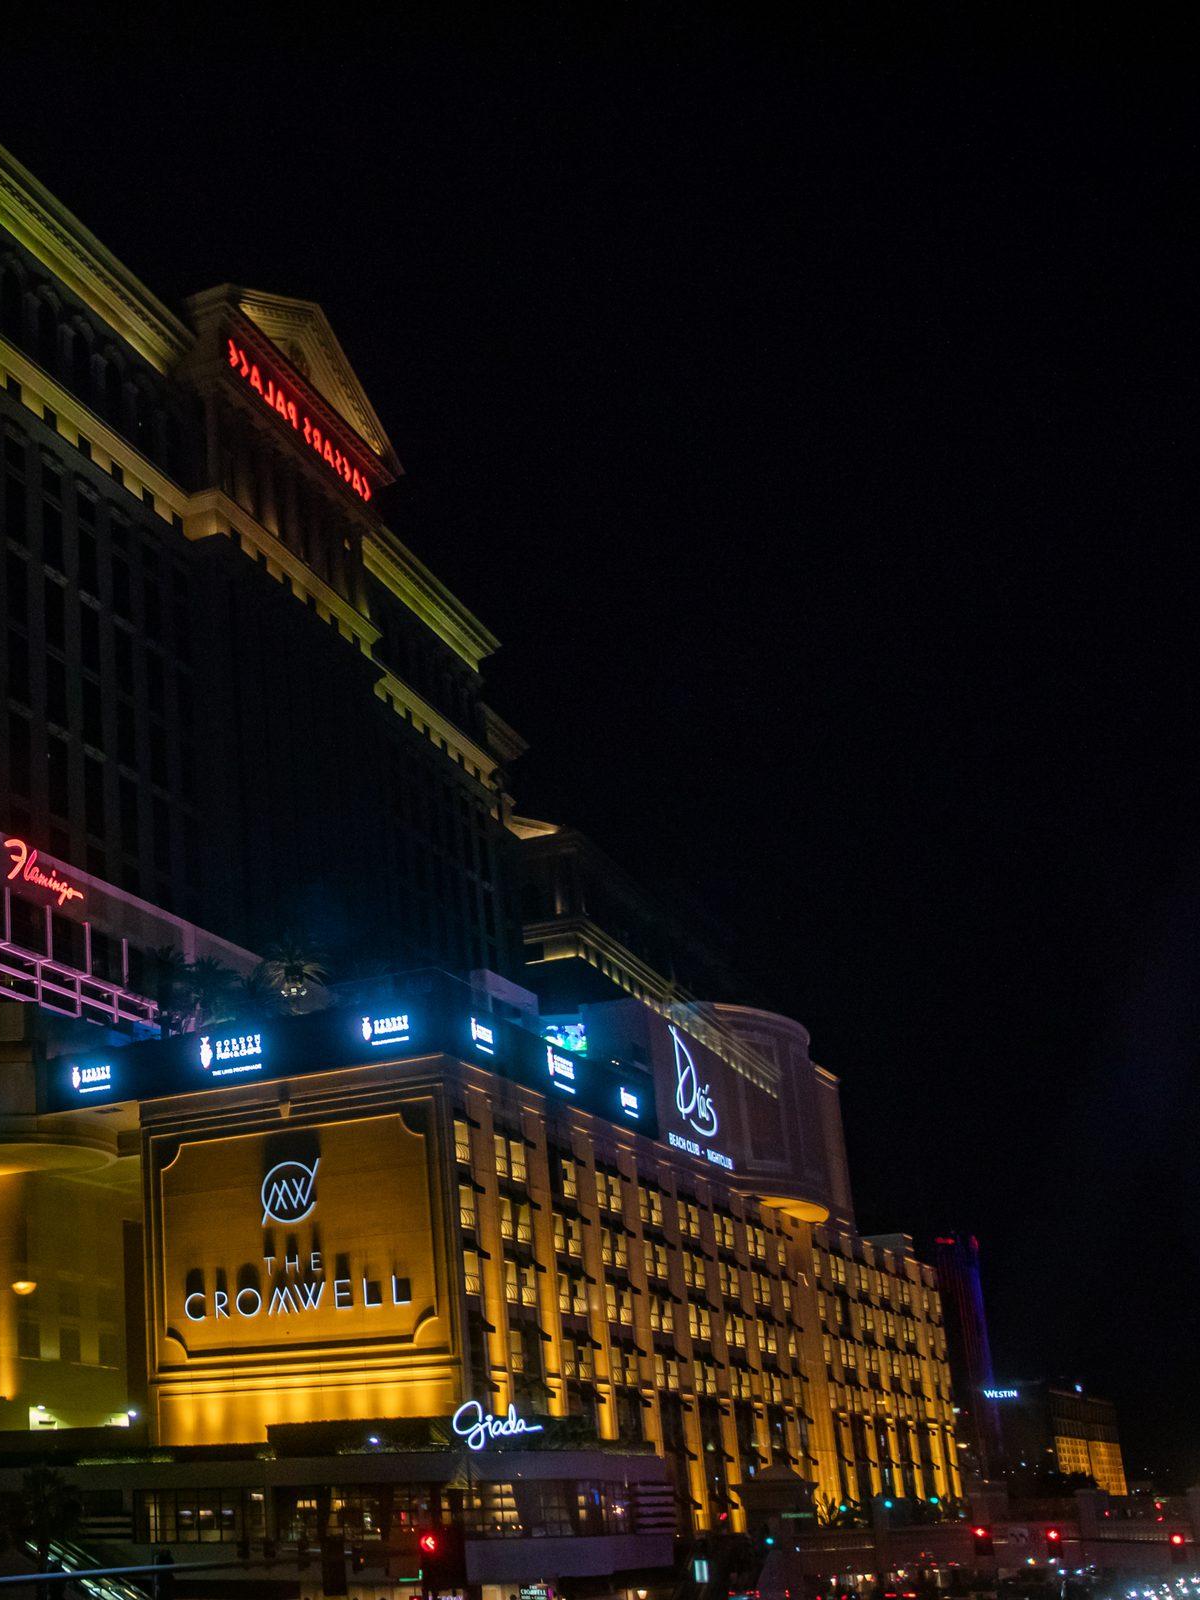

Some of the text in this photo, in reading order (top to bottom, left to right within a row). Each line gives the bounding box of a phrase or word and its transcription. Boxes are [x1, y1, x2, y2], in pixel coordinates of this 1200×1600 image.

[4, 838, 84, 906] Flamingo
[668, 1132, 686, 1150] BEACH
[686, 1139, 700, 1156] CLUB
[263, 1251, 323, 1277] THE
[184, 1274, 412, 1321] CROMWELL
[983, 1389, 1018, 1399] WESTIN
[452, 1400, 544, 1450] Giada
